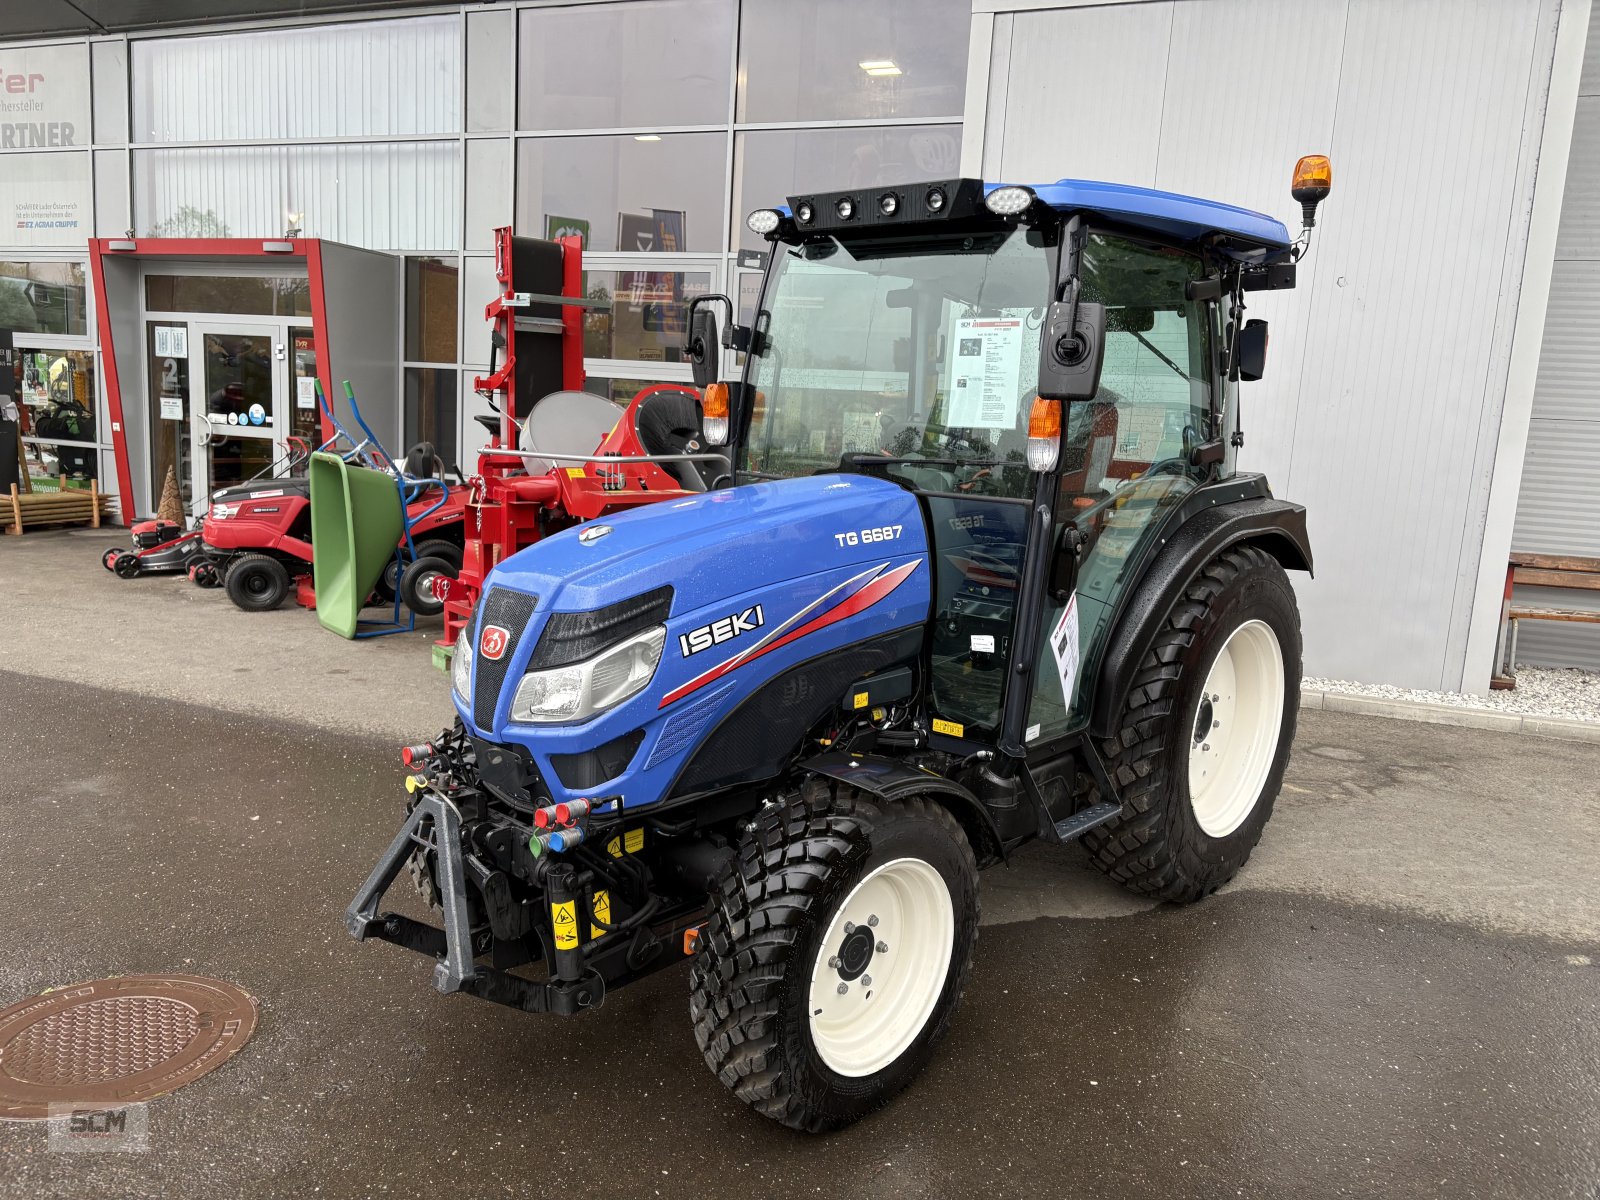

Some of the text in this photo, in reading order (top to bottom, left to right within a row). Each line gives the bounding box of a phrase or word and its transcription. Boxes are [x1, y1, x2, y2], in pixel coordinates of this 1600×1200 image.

[0, 68, 45, 93] er
[0, 99, 44, 112] hersteller
[0, 122, 75, 149] RTNER
[834, 524, 903, 548] TG 6687
[678, 604, 765, 658] ISEKI
